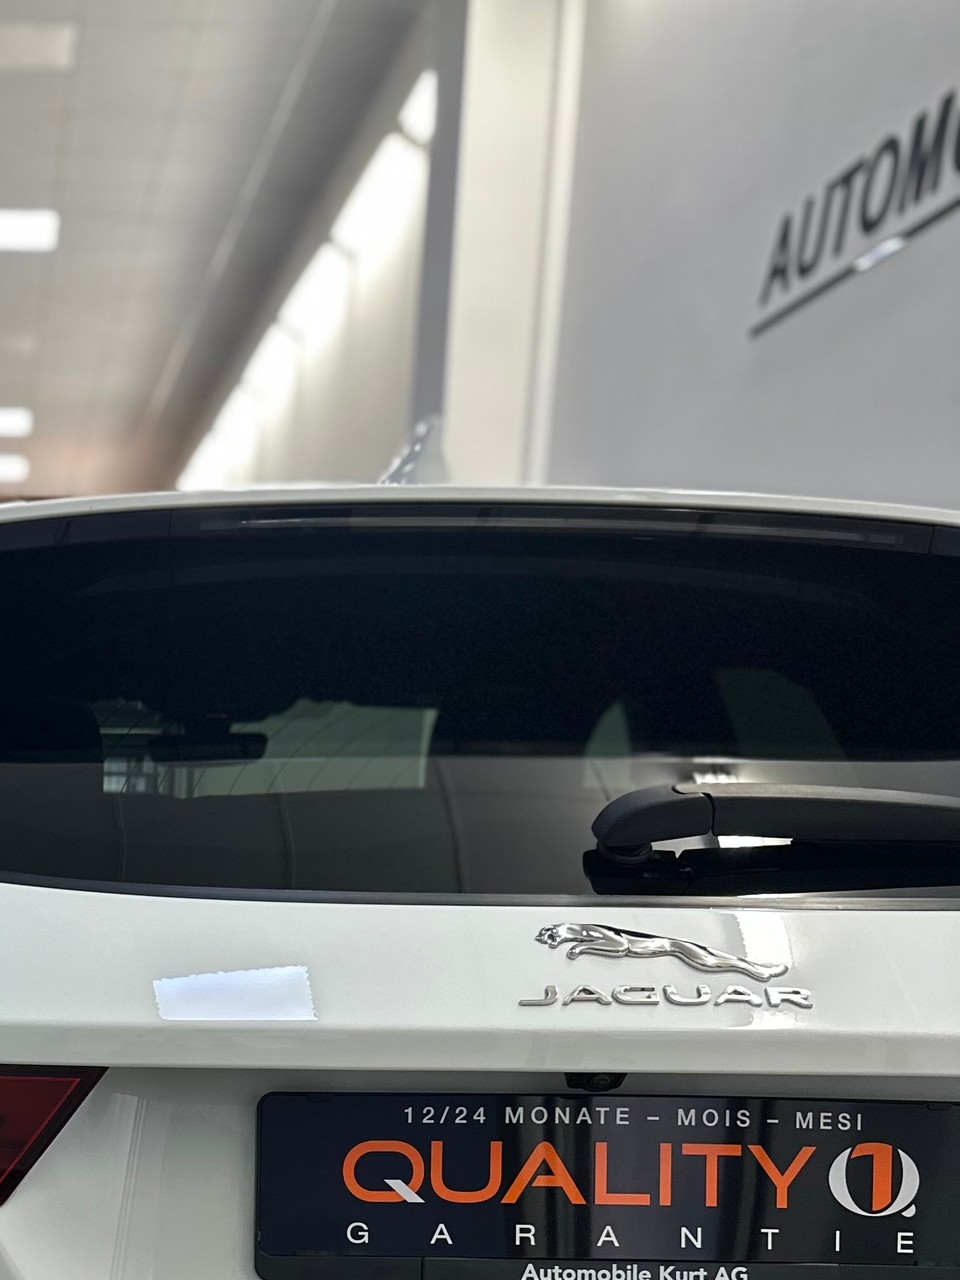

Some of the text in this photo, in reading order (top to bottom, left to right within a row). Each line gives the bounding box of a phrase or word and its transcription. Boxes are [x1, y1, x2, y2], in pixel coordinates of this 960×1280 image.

[757, 88, 960, 307] AUTOM
[518, 984, 813, 1009] JAGUAR
[403, 1106, 486, 1124] 12/24
[504, 1106, 630, 1125] MONATE
[676, 1109, 752, 1128] MOIS
[796, 1112, 864, 1131] MESI
[342, 1140, 817, 1210] QUALITY
[346, 1222, 915, 1254] GARANTIE
